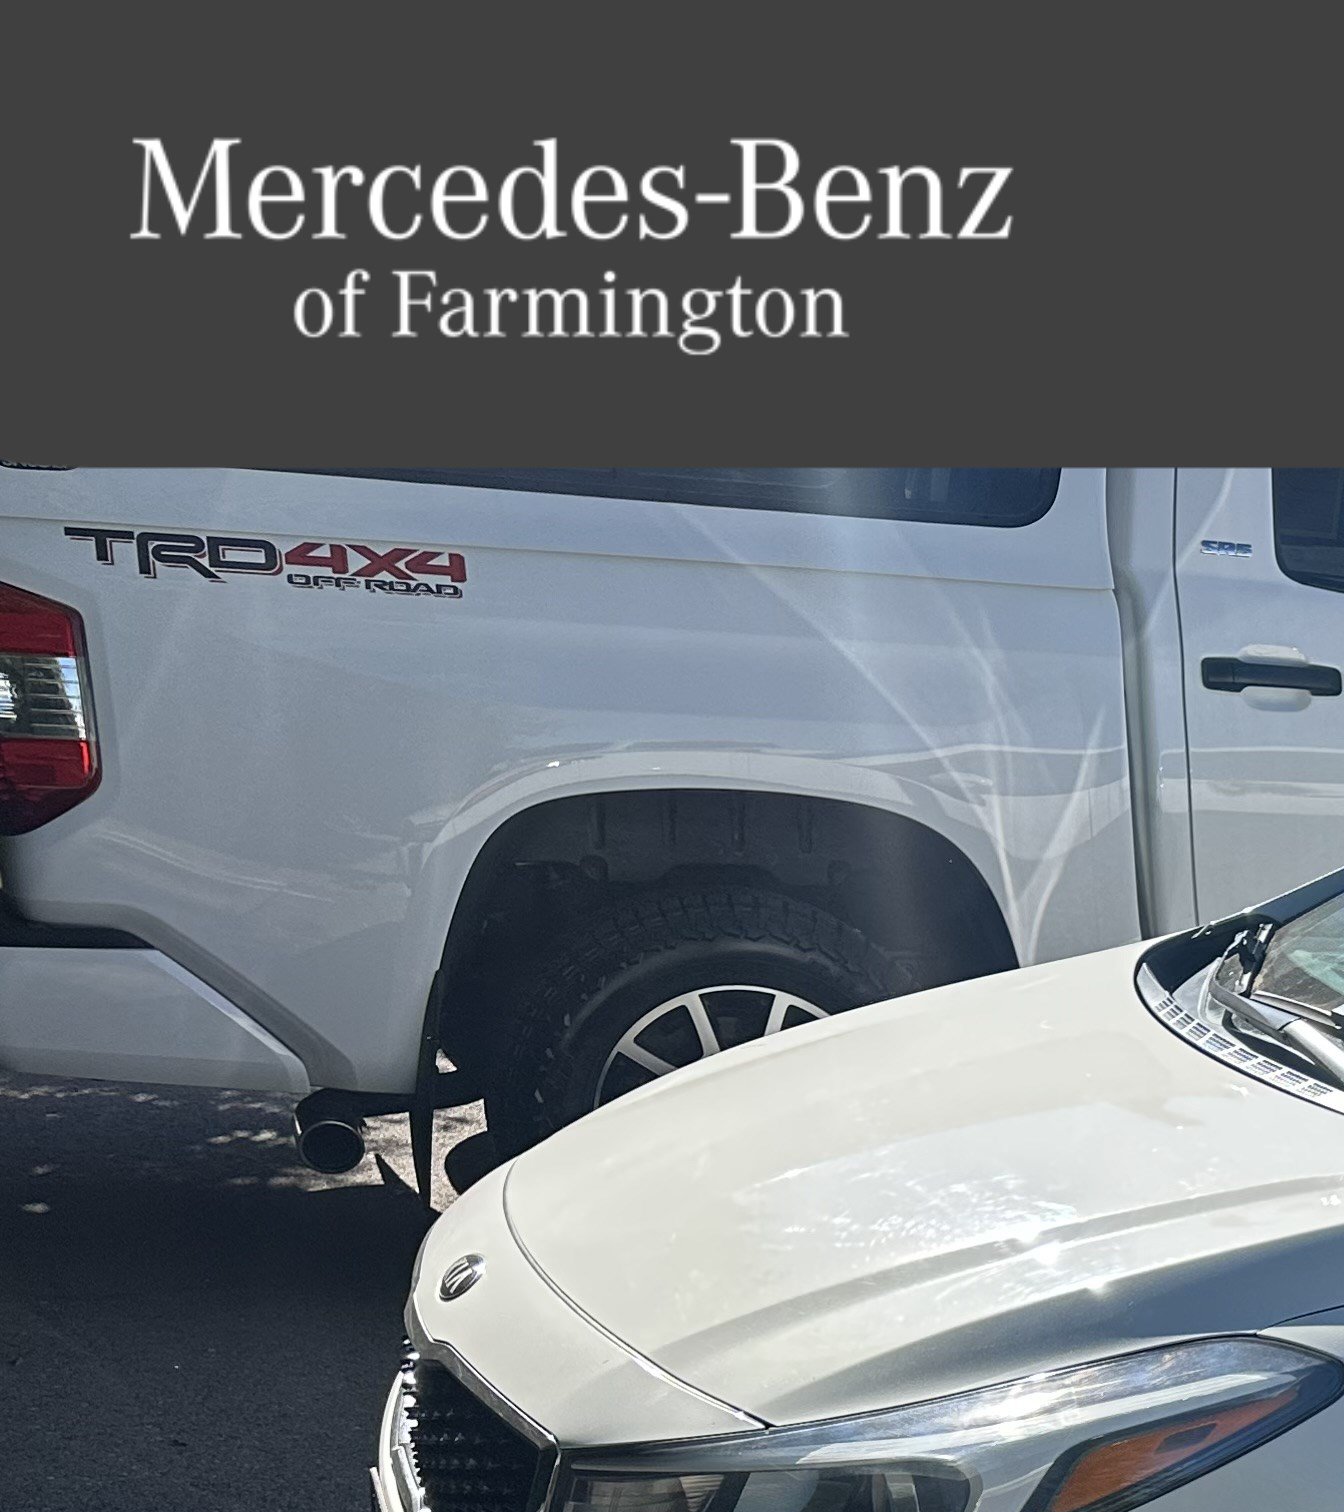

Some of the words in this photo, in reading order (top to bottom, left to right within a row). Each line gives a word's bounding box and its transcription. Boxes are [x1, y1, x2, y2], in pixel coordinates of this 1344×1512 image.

[64, 526, 283, 583] TRD
[287, 574, 361, 591] OFF
[364, 578, 464, 598] ROAD
